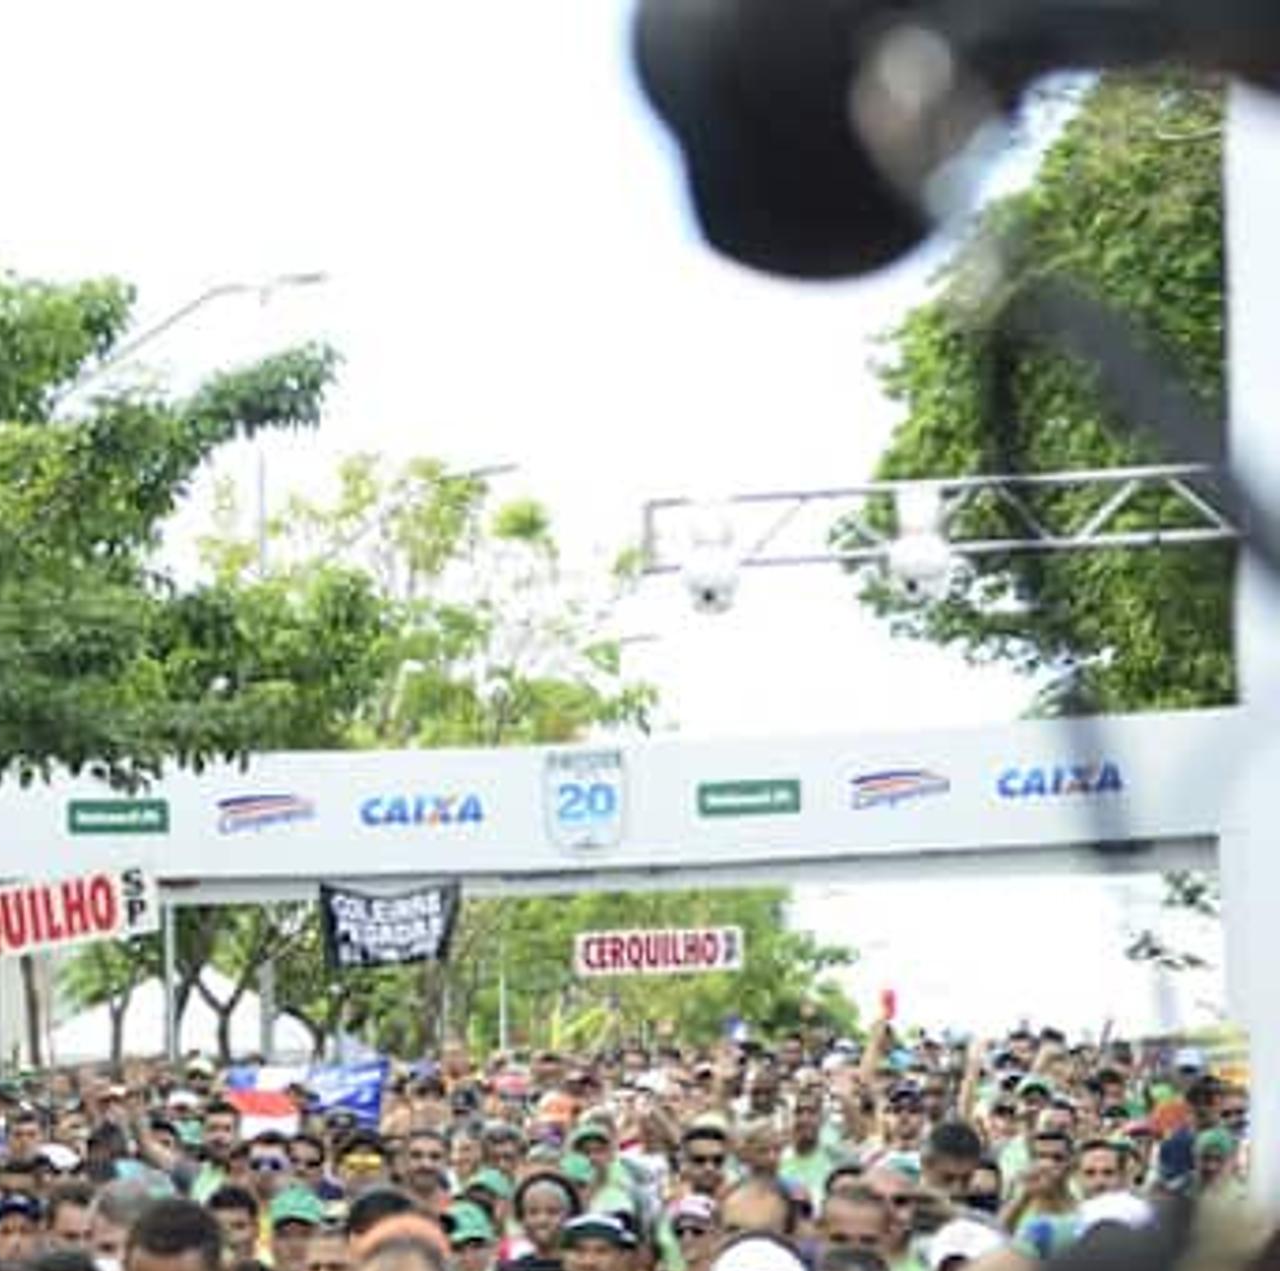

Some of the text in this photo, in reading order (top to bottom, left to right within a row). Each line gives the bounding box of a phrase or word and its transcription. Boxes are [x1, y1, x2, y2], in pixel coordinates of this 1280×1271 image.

[996, 759, 1125, 800] CAIXA
[360, 792, 483, 826] CAIXA
[557, 783, 616, 820] 20
[583, 932, 718, 968] CERQUILHO
